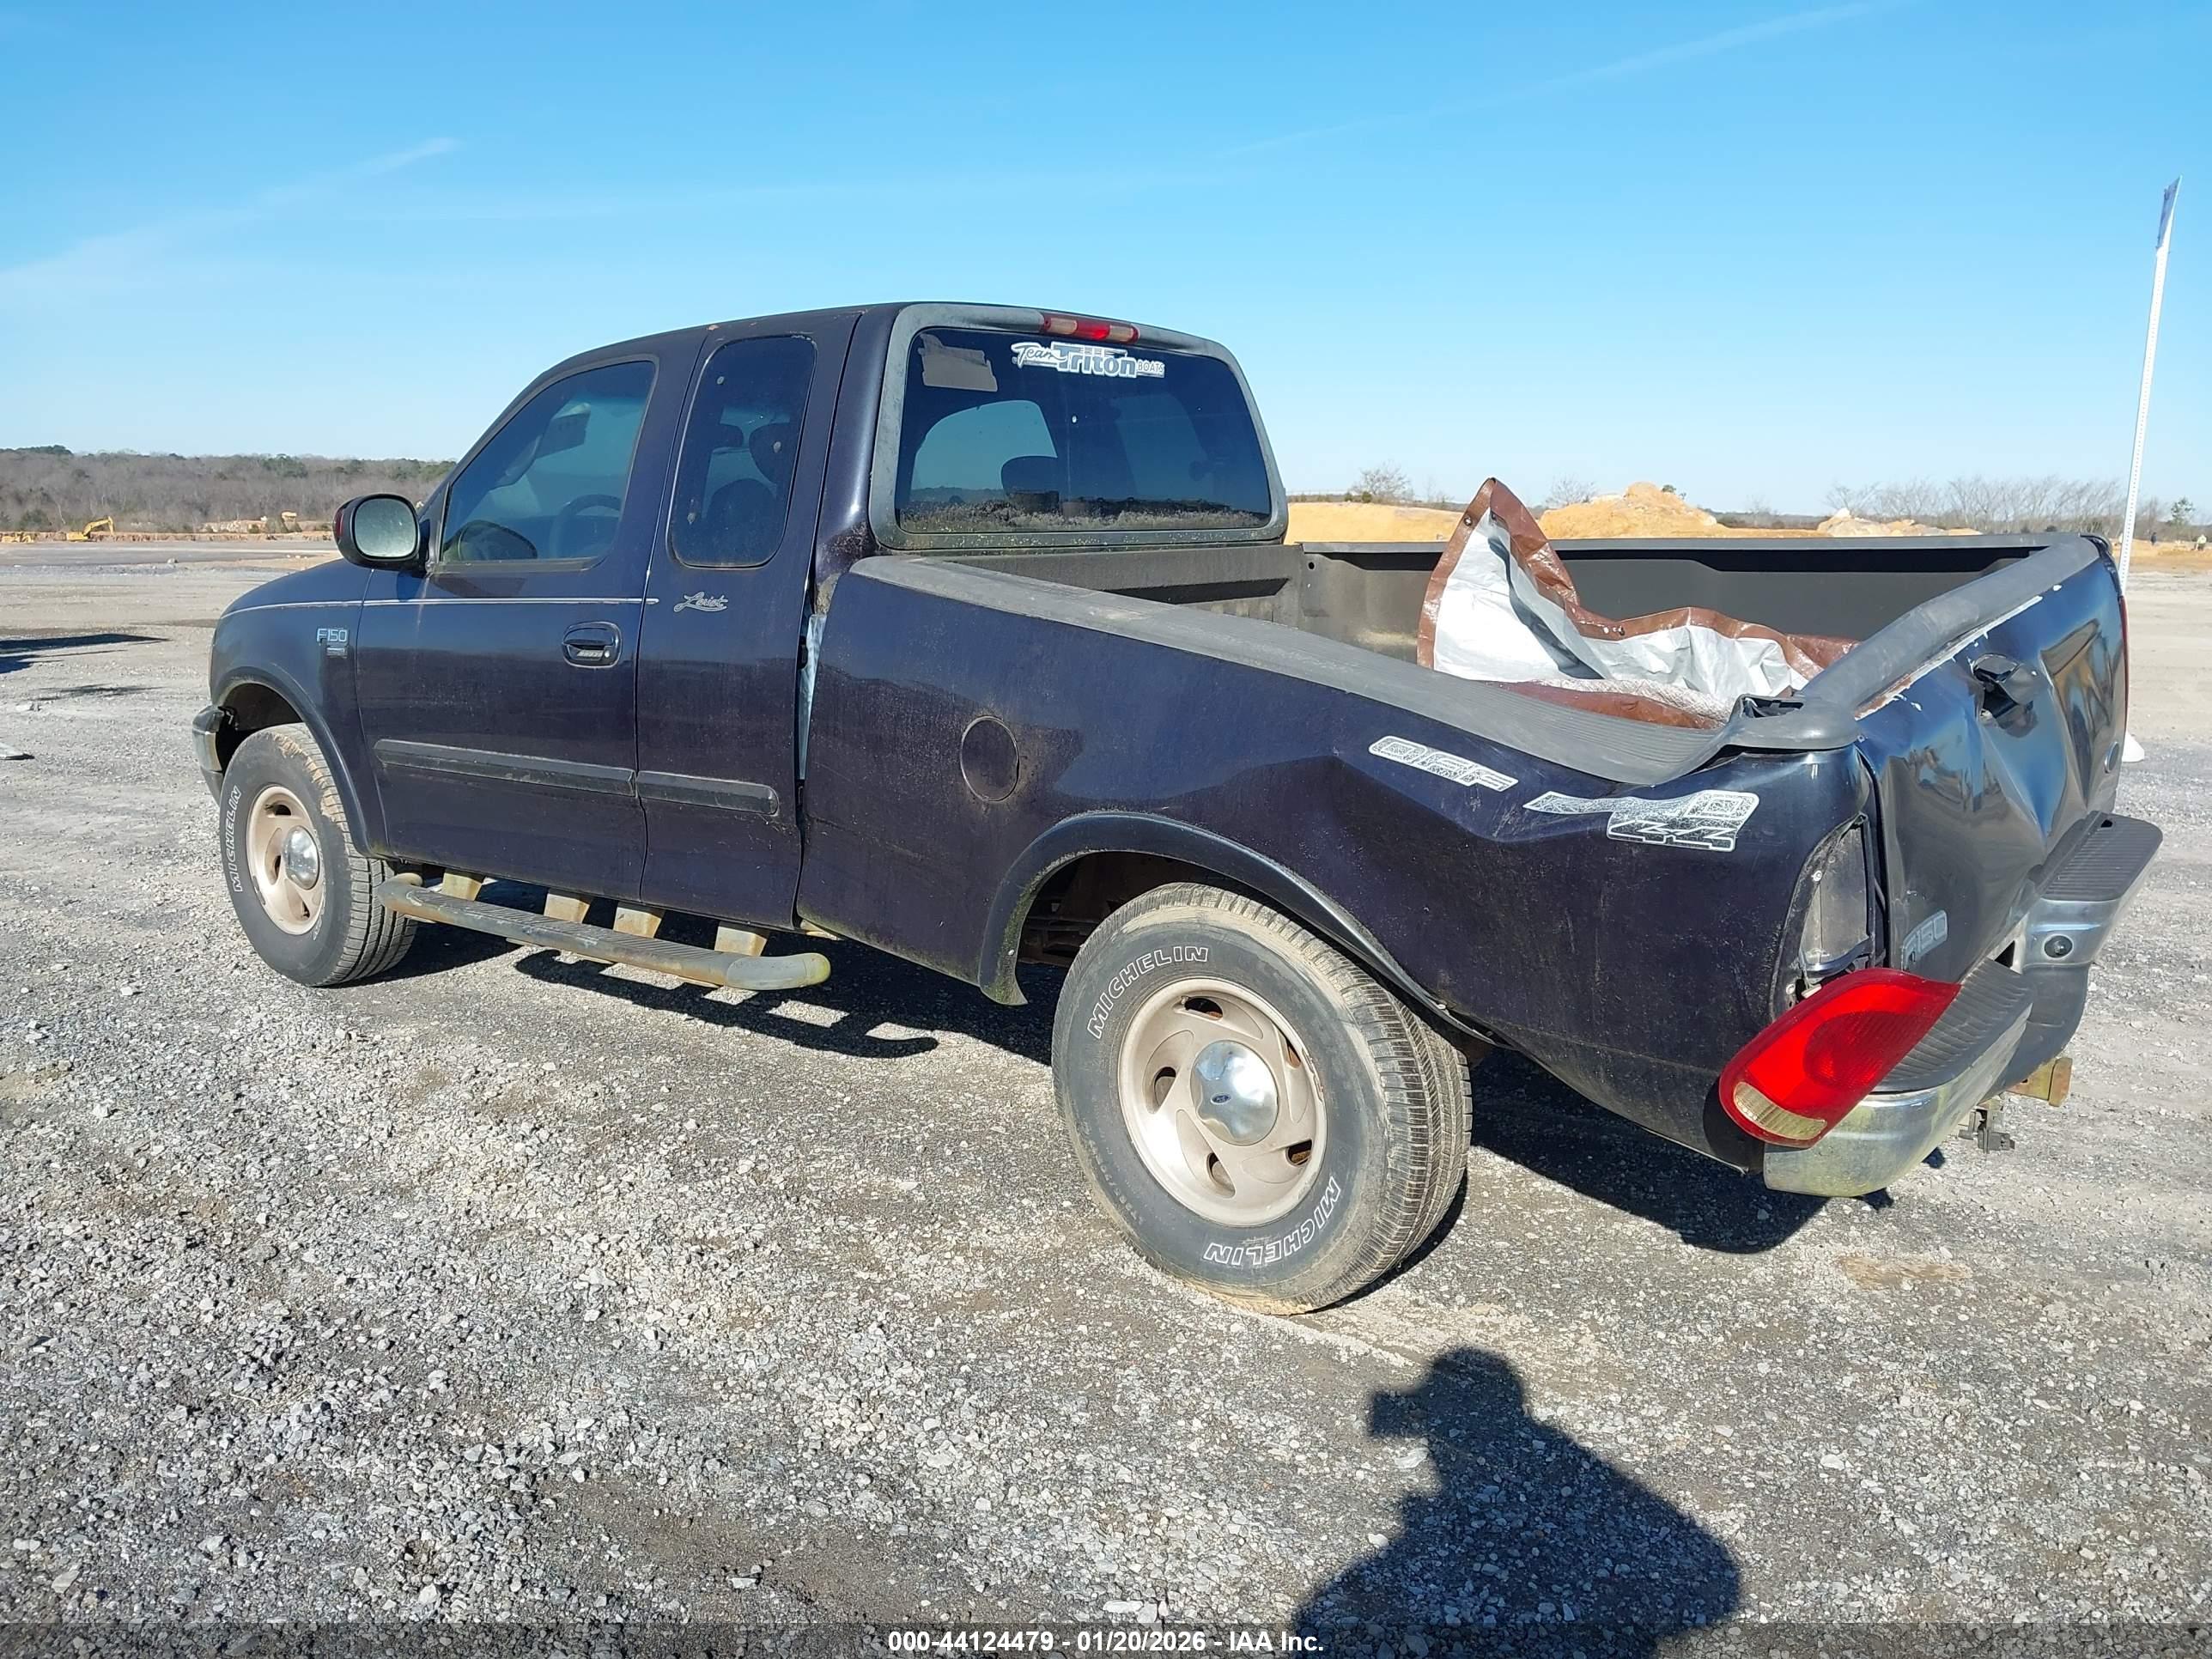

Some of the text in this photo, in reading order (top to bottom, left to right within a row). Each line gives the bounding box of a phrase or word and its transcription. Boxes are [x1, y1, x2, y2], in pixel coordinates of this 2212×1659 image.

[1013, 342, 1164, 378] Team Triton BOATS
[223, 784, 241, 893] MICHELIN
[1087, 945, 1209, 1040] MICHELIN
[1203, 1176, 1341, 1267] MICHELIN
